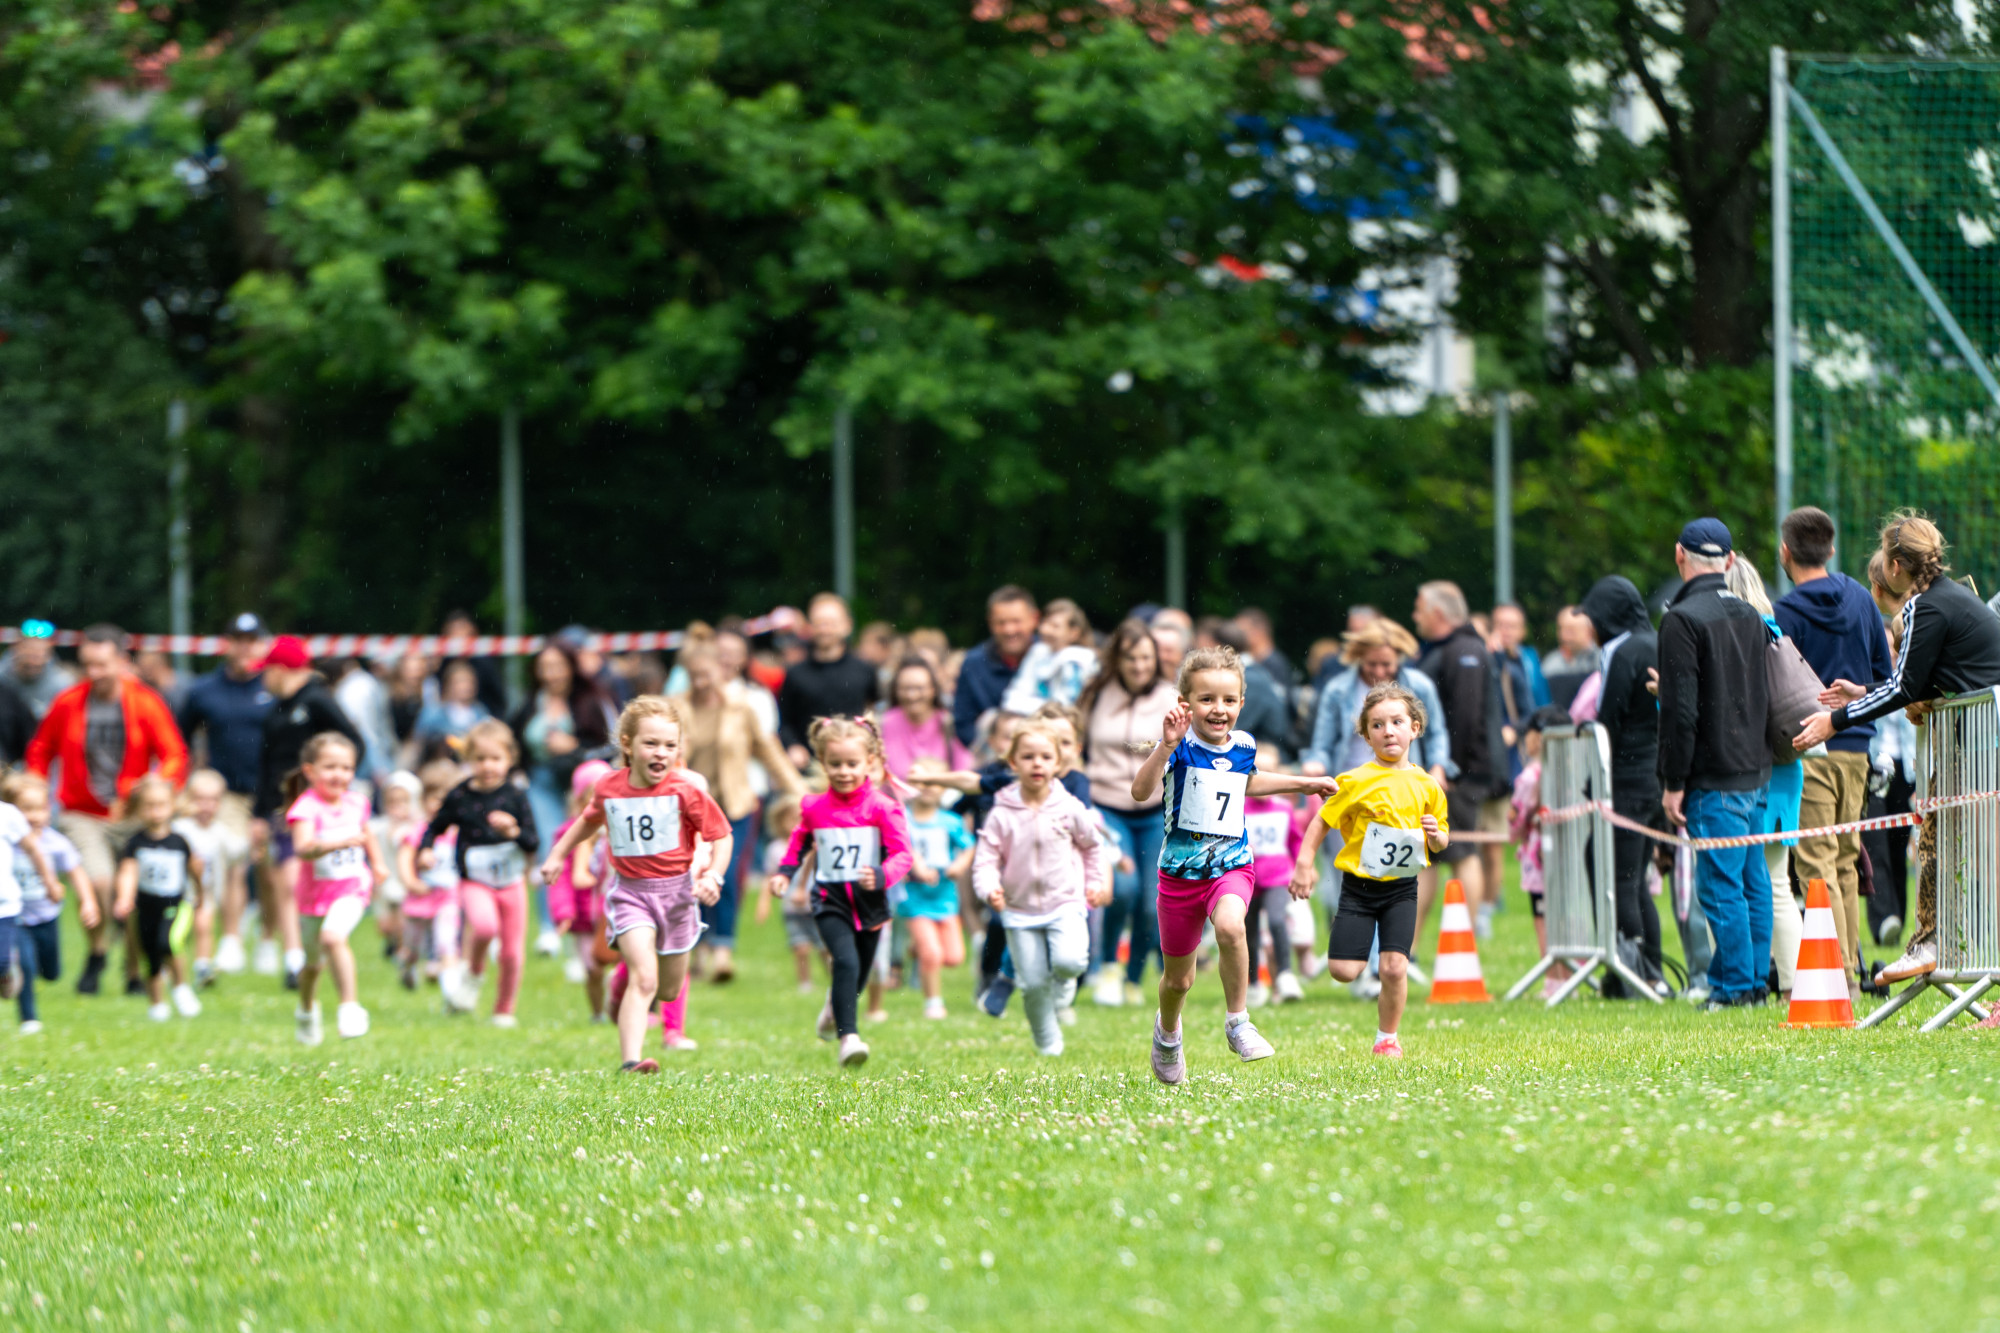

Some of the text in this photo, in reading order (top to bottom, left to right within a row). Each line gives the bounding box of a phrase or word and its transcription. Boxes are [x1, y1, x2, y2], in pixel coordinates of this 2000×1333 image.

[1216, 791, 1231, 821] 7
[625, 814, 655, 842] 18
[831, 844, 861, 870] 27
[1380, 842, 1413, 868] 32
